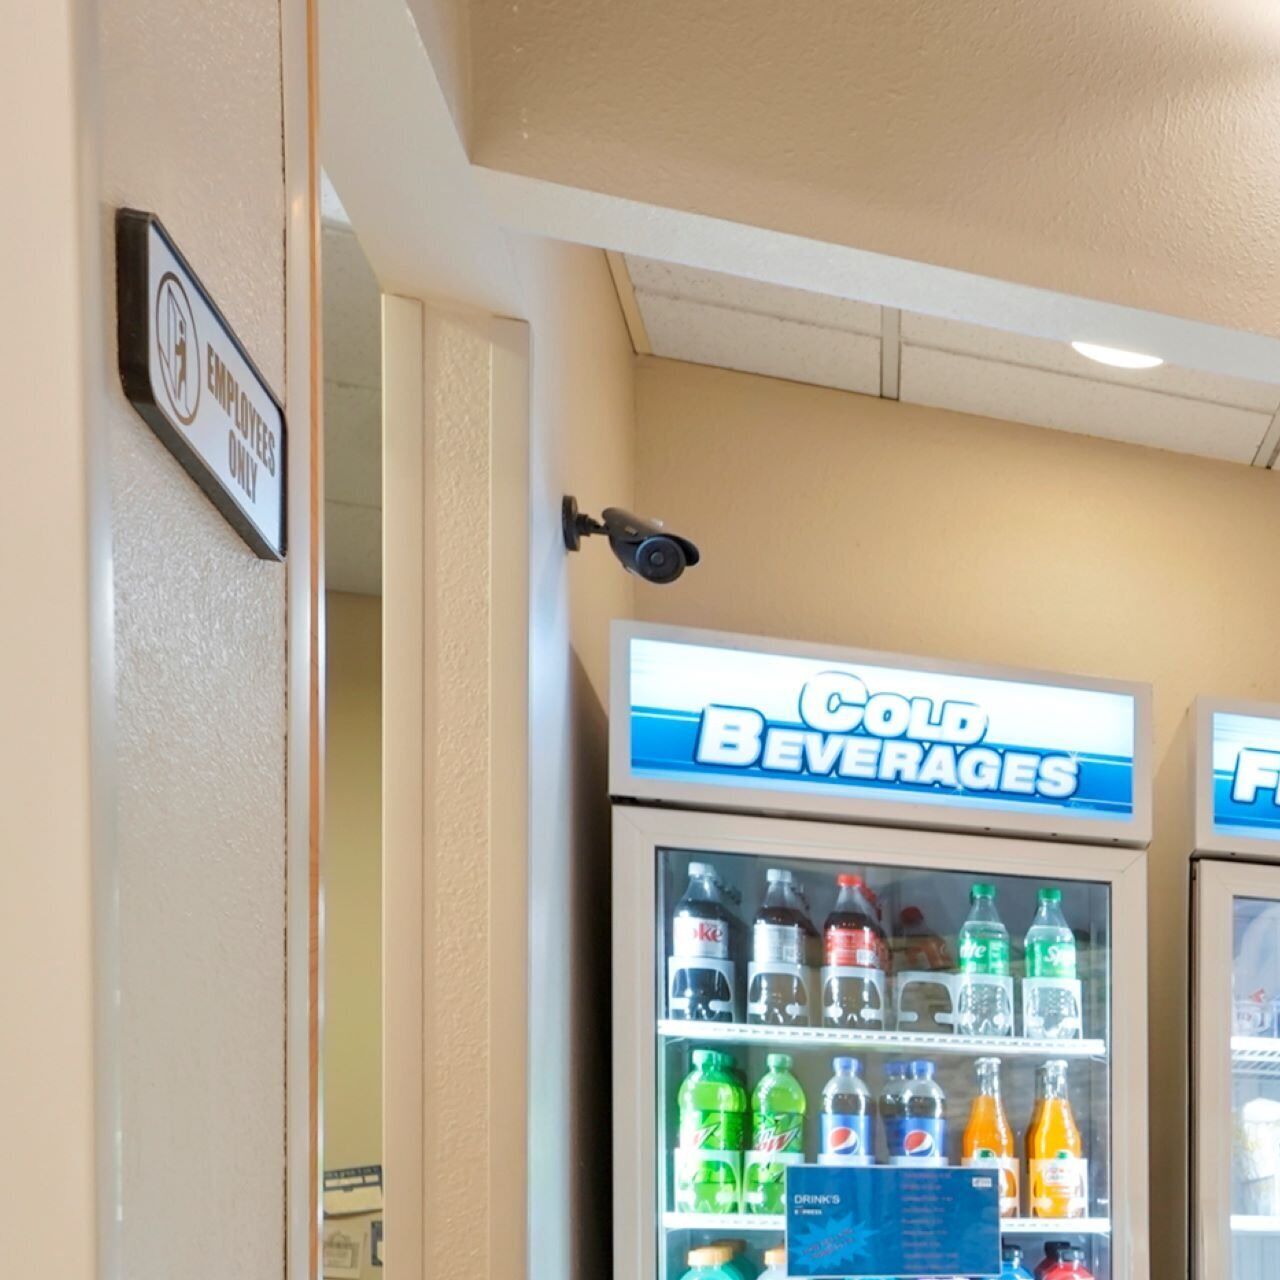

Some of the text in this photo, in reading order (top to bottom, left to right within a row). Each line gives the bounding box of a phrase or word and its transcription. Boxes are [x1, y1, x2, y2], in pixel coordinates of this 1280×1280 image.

[206, 343, 276, 479] EMPLOYEES
[228, 427, 258, 505] ONLY
[798, 671, 989, 745] COLD
[694, 704, 1082, 799] BEVERAGES
